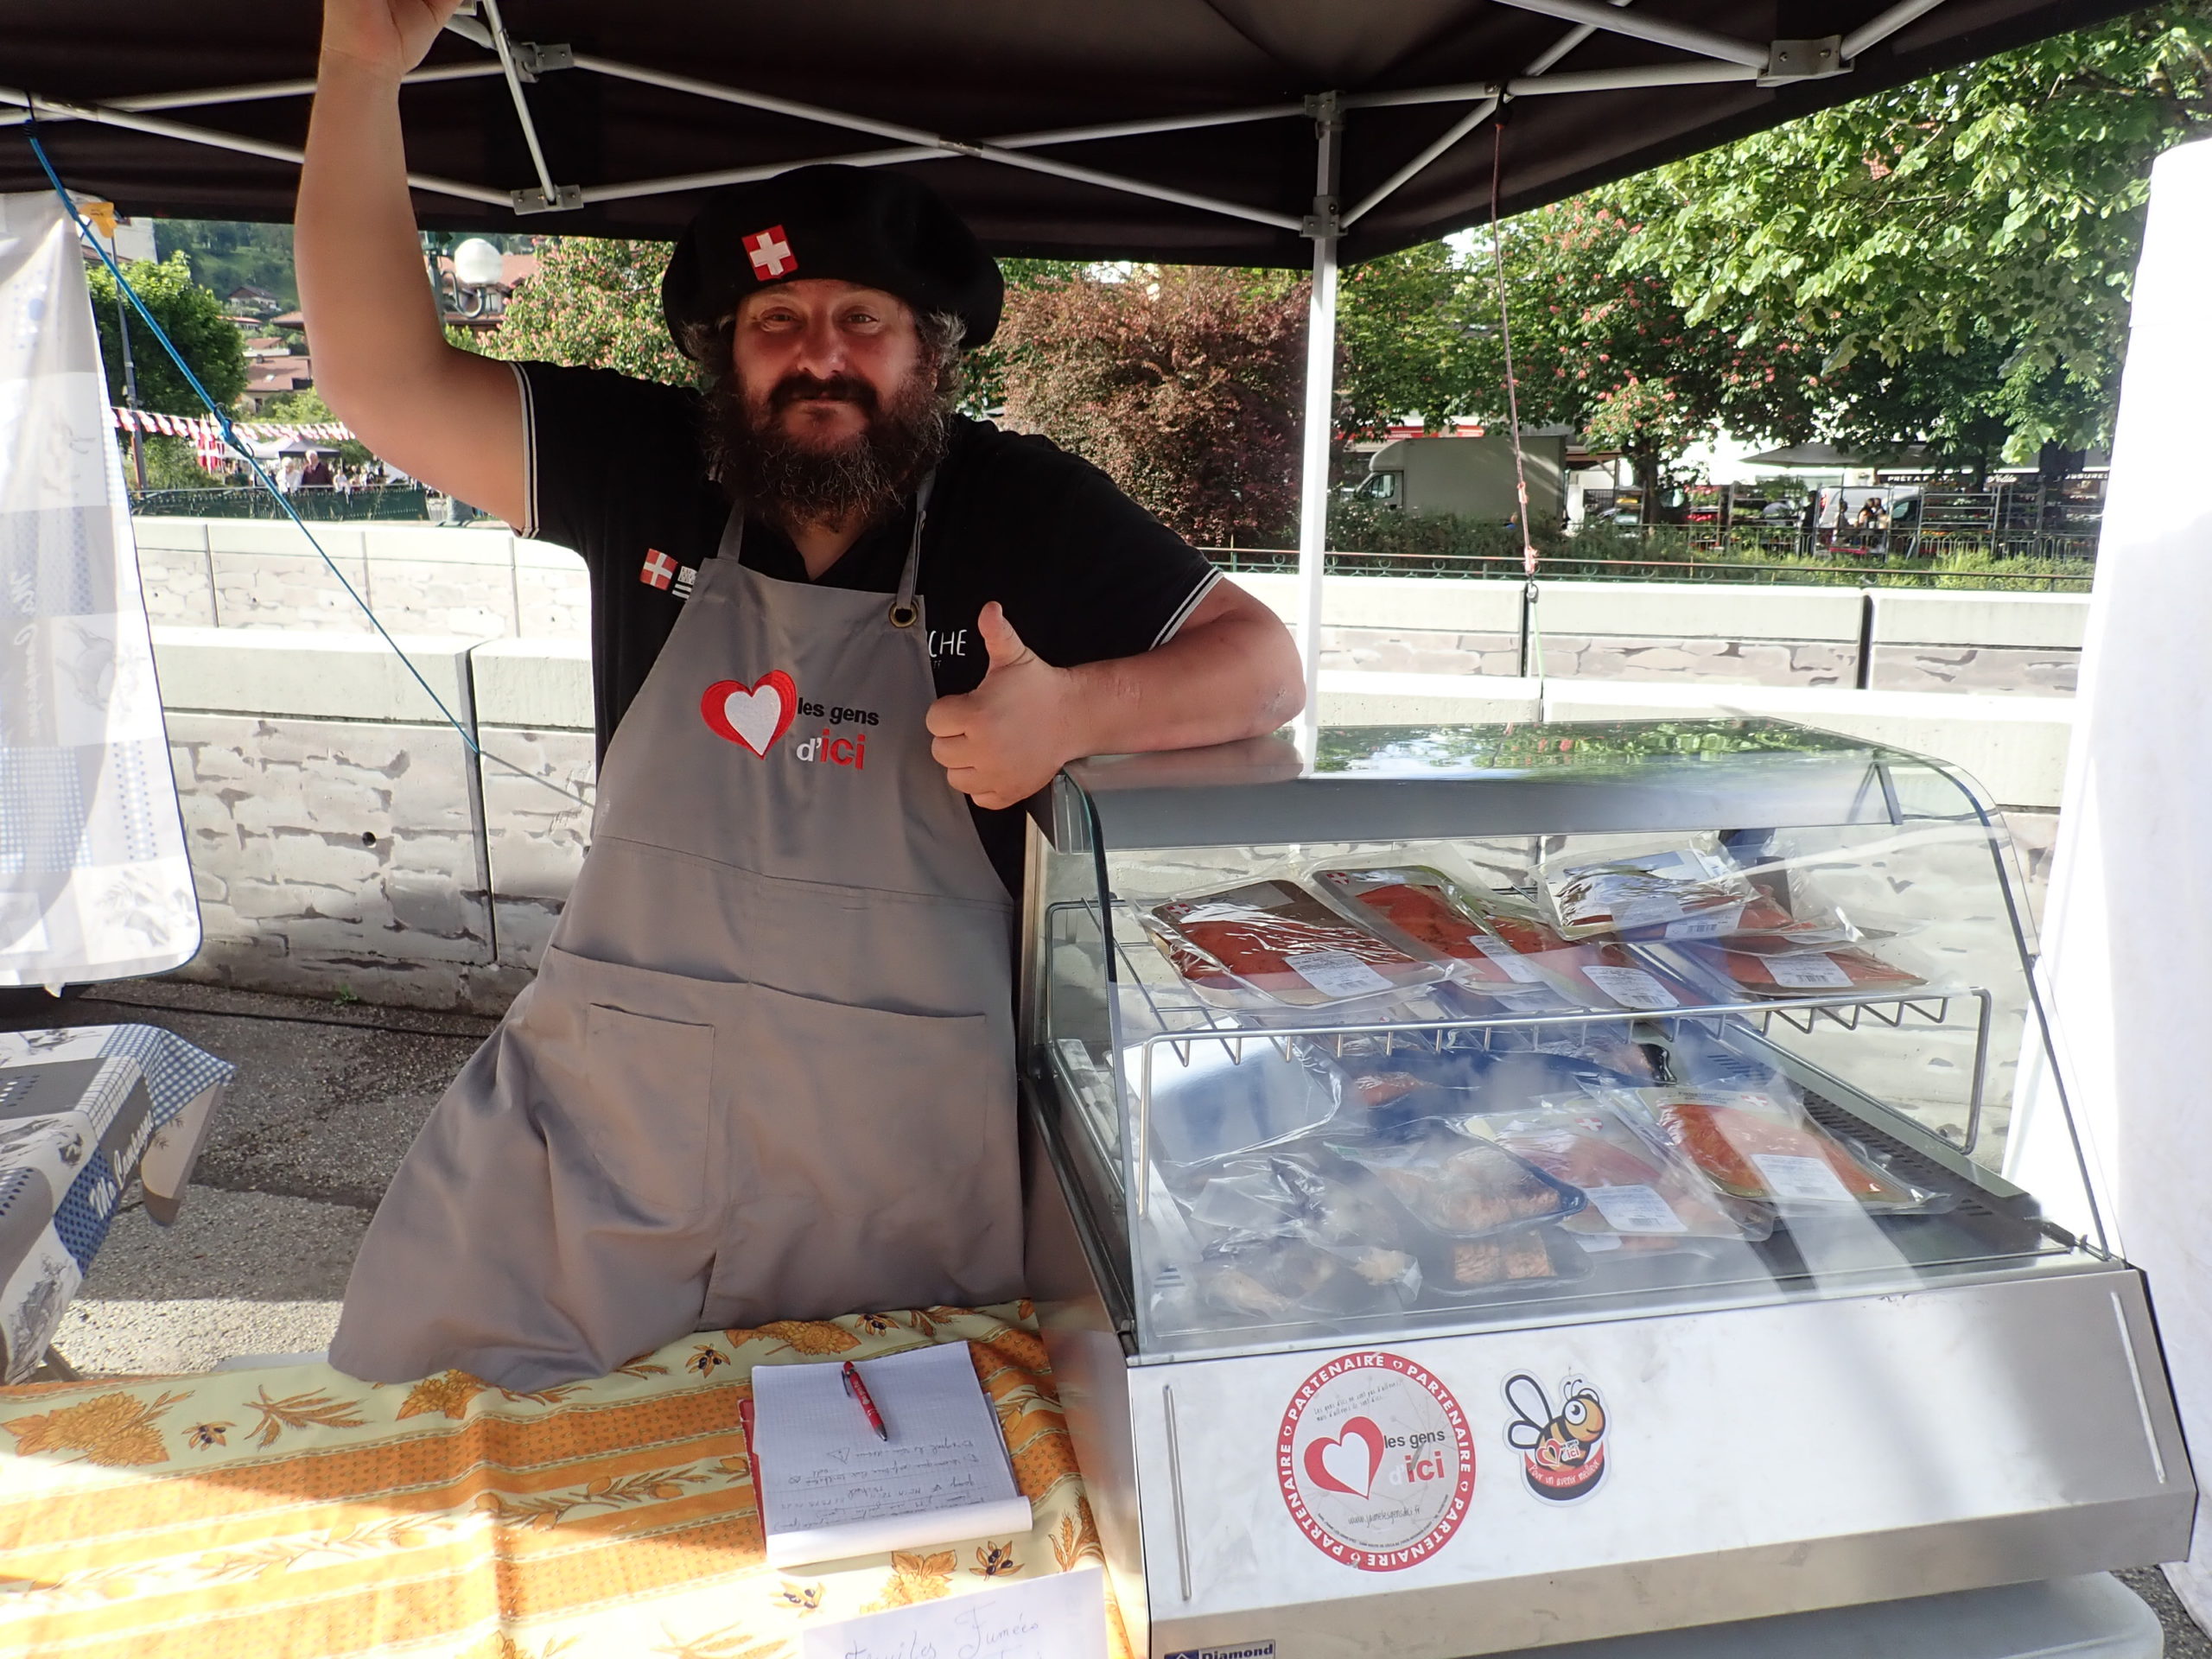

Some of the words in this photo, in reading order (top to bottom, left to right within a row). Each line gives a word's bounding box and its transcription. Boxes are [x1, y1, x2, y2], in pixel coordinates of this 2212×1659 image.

[797, 696, 825, 717] les
[829, 706, 880, 726] gens
[796, 728, 866, 770] d'ici
[1287, 1355, 1384, 1421] PARTENAIRE
[1384, 1434, 1406, 1448] les
[1409, 1430, 1446, 1450] gens
[1407, 1364, 1471, 1473] PARTENAIRE
[1389, 1451, 1445, 1486] d'ici
[1281, 1444, 1344, 1556] PARTENAIRE
[1368, 1497, 1465, 1567] PARTENAIRE
